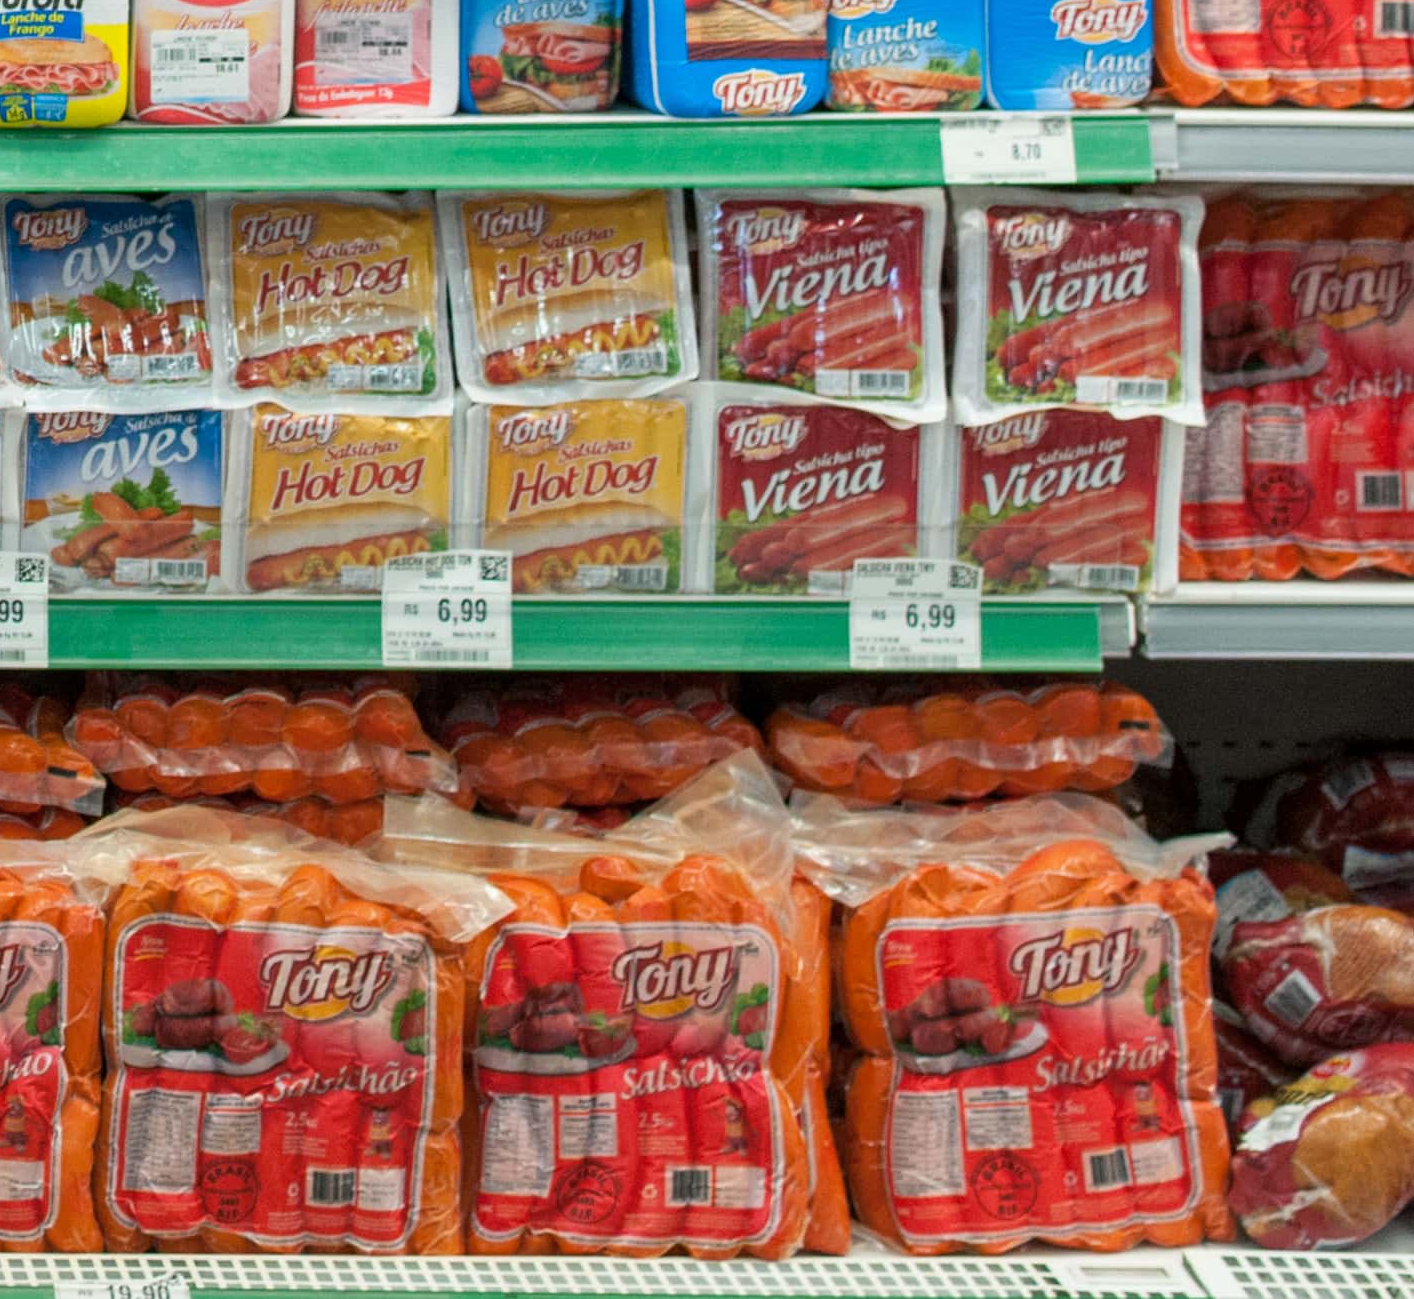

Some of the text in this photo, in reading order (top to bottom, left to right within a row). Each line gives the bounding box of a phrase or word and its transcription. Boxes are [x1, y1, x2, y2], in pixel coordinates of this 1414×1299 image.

[843, 19, 938, 47] Lanche
[744, 251, 891, 323] Viena
[1059, 247, 1149, 277] Salsicha tipo
[80, 423, 201, 483] aves
[324, 439, 401, 462] Salsichas
[272, 456, 425, 511] Hot Dog
[741, 456, 885, 523] Viena
[438, 598, 487, 626] 6,99
[906, 604, 955, 630] 6,99
[263, 948, 392, 1011] Tony
[614, 941, 737, 1008] Tony
[1011, 928, 1139, 999] Tony
[269, 1065, 419, 1101] Salsichão
[1033, 1036, 1171, 1093] Salsichão
